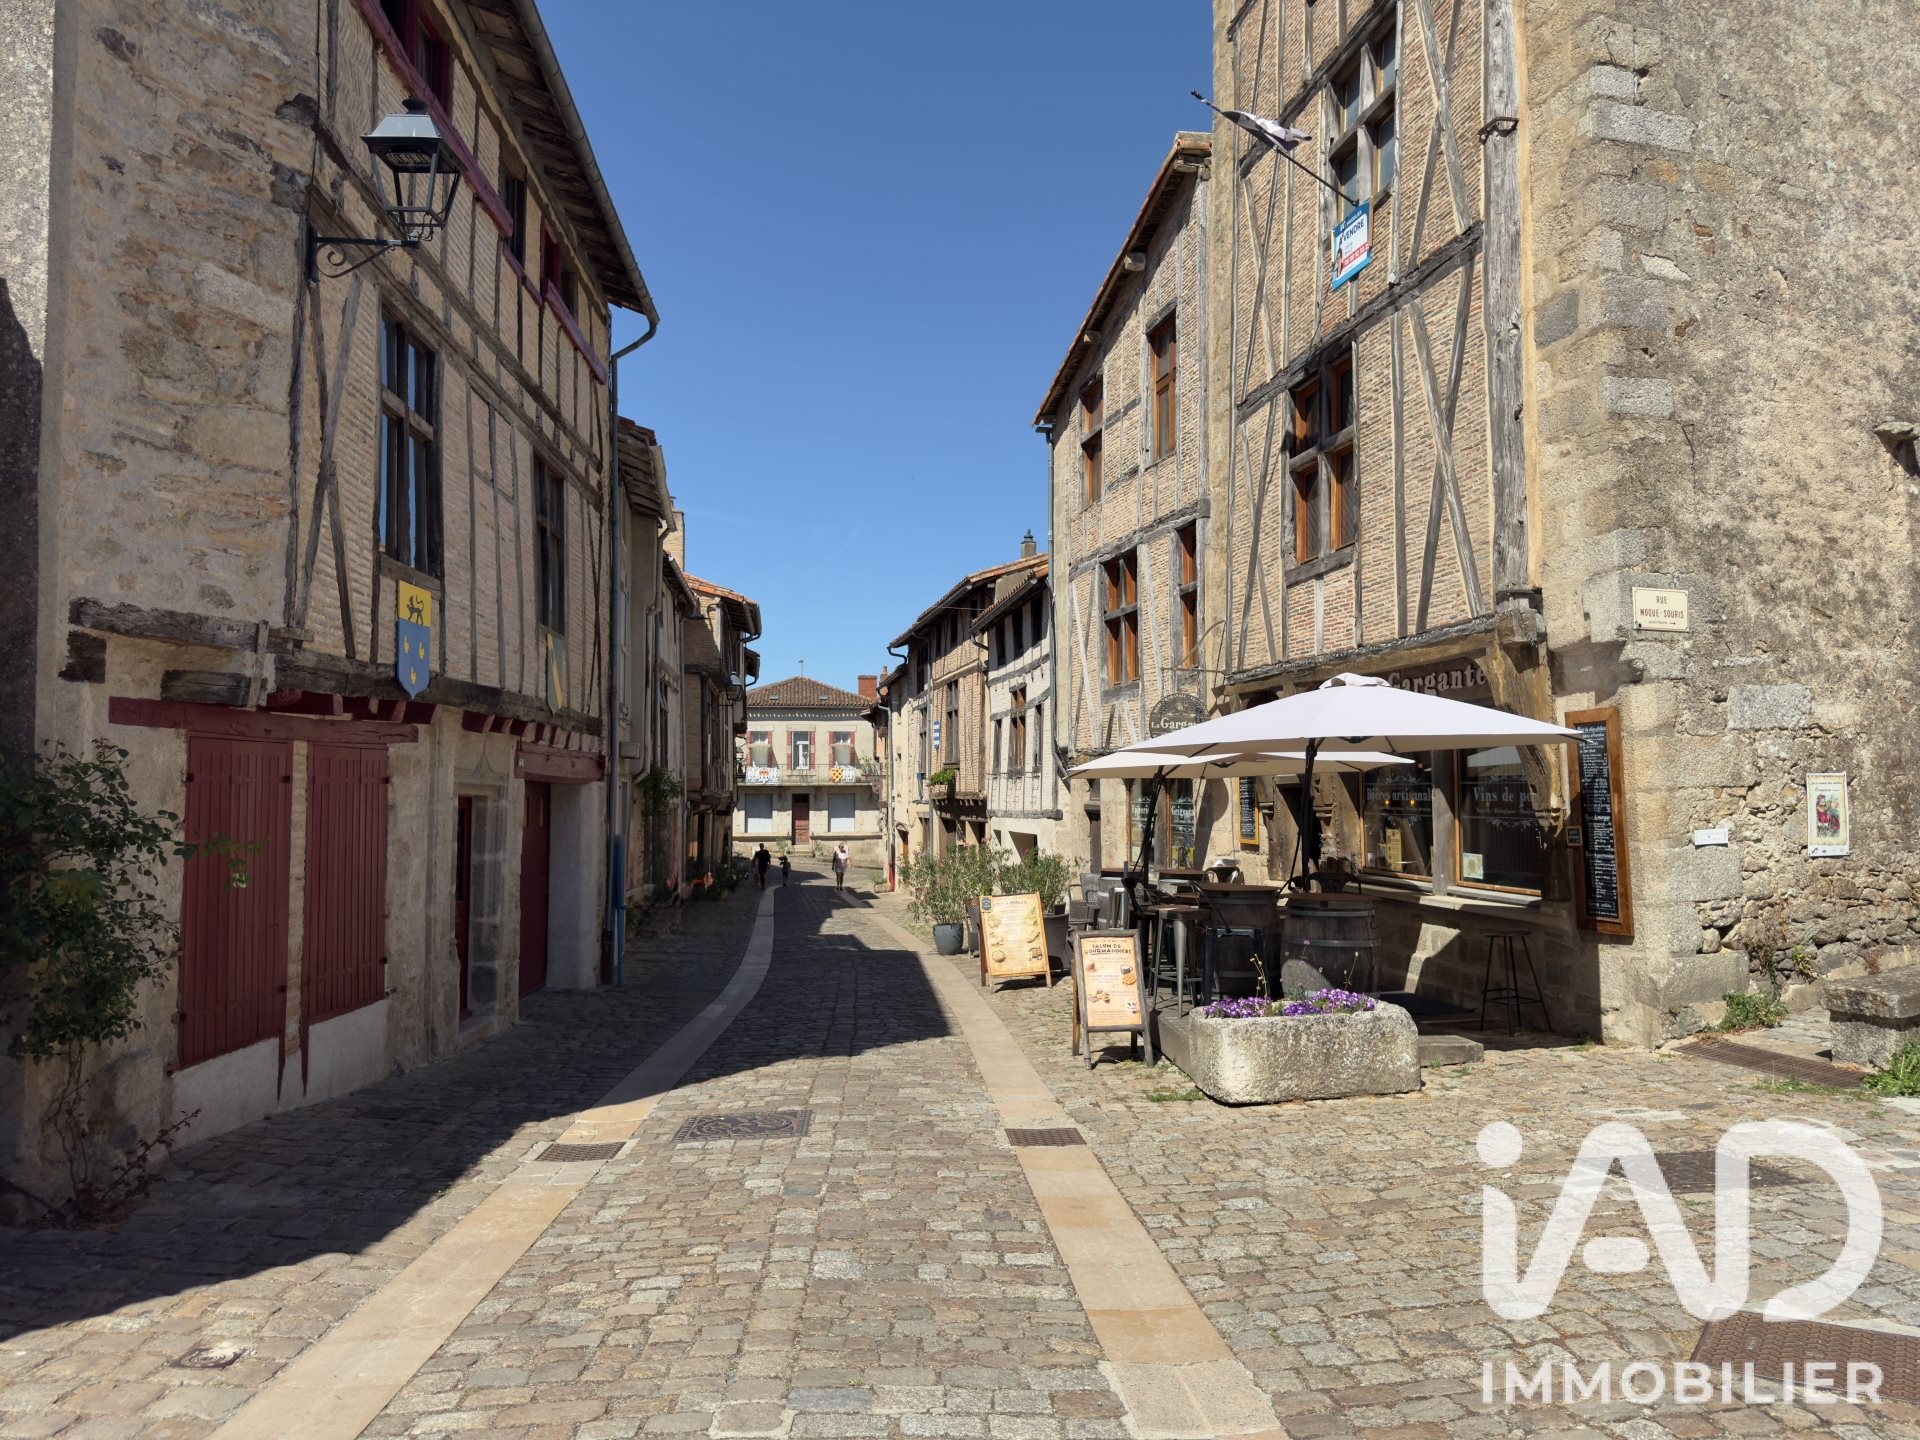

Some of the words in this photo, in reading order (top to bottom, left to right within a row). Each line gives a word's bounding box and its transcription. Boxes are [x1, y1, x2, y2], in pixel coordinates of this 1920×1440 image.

[1656, 595, 1667, 604] RUE
[1392, 788, 1432, 801] artisanal
[1472, 786, 1498, 802] Vins
[1502, 785, 1515, 802] de
